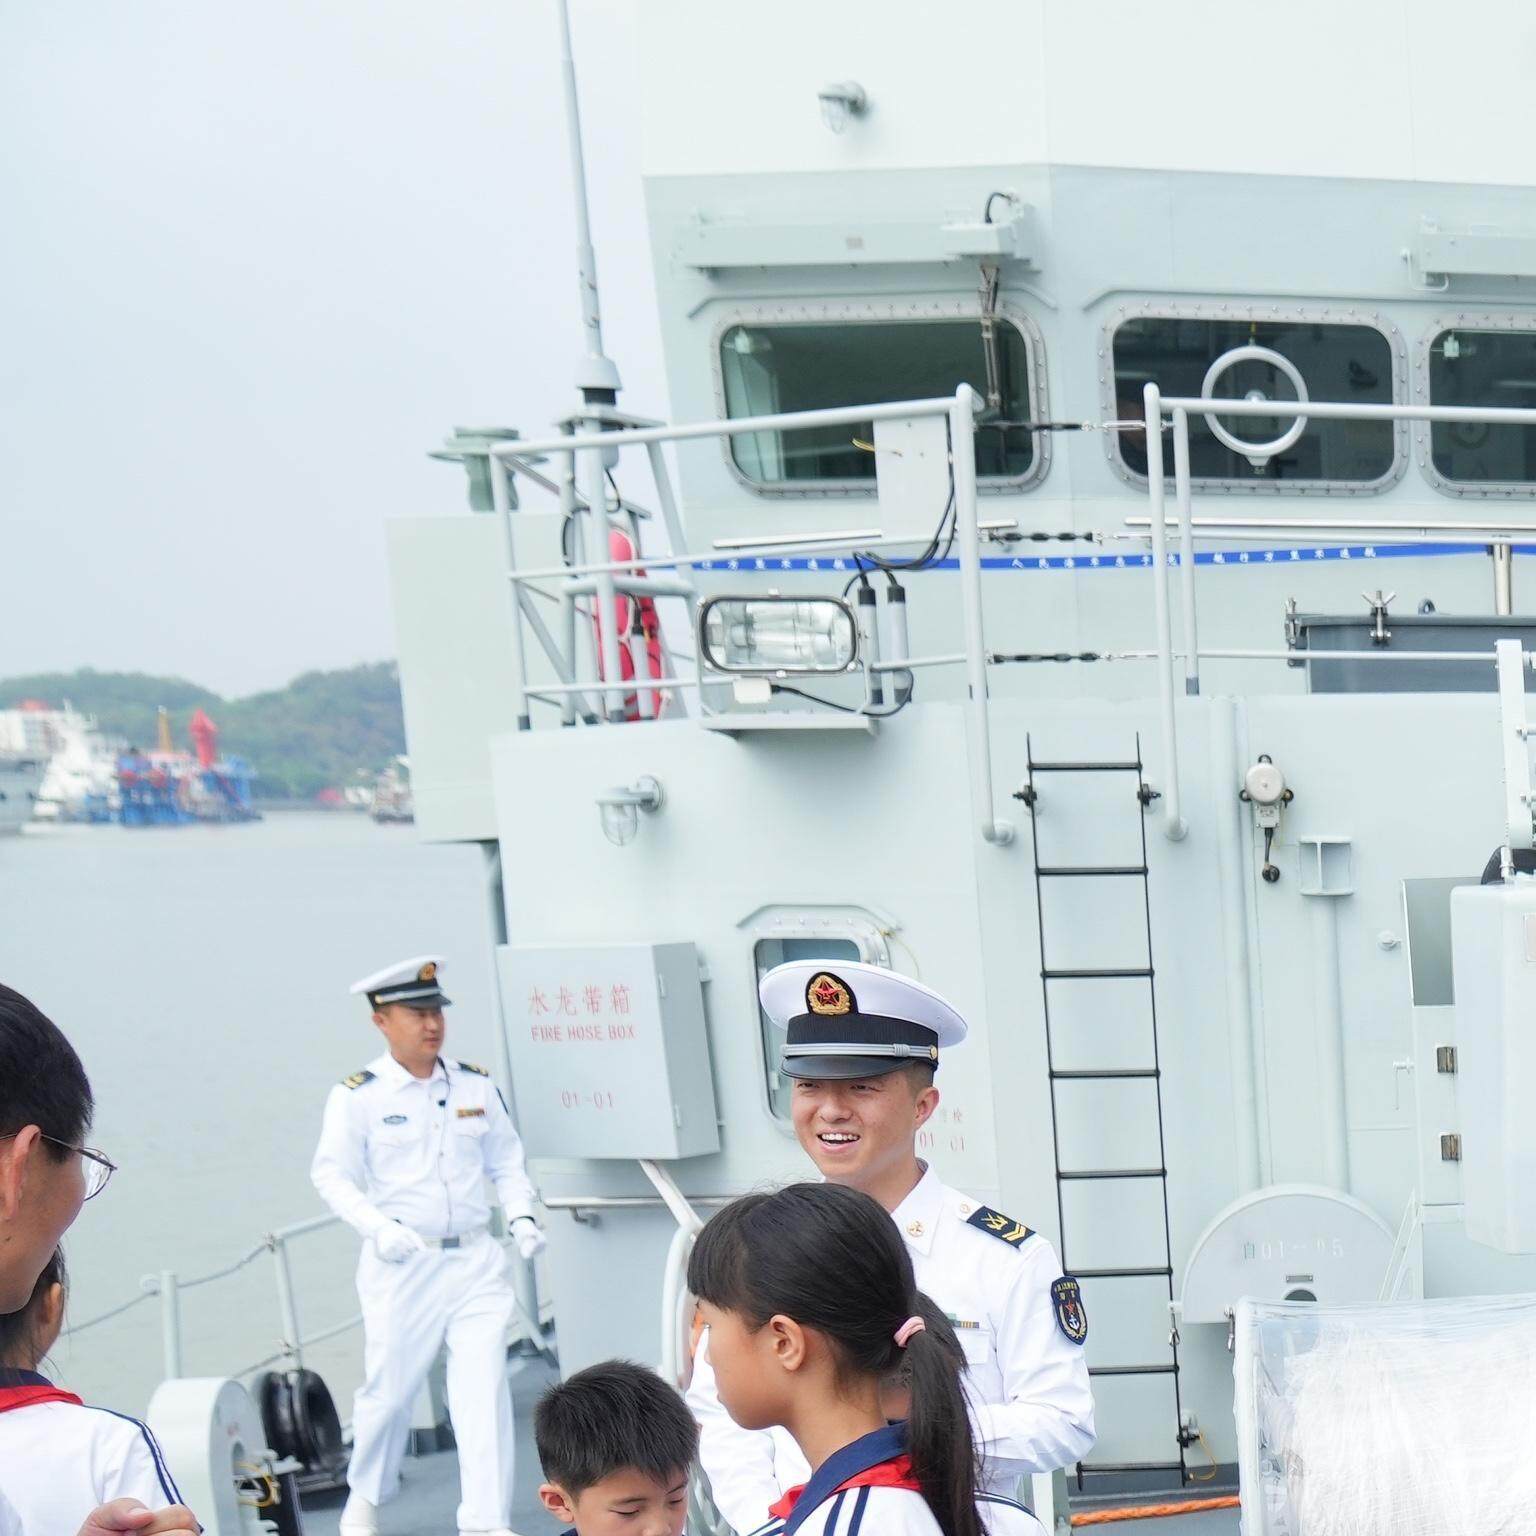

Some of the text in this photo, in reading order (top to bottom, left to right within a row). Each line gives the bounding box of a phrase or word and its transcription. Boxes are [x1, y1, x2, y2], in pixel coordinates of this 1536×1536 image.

[527, 982, 632, 1016] 水龙带箱
[530, 1024, 637, 1042] FIRE HOSE BOX
